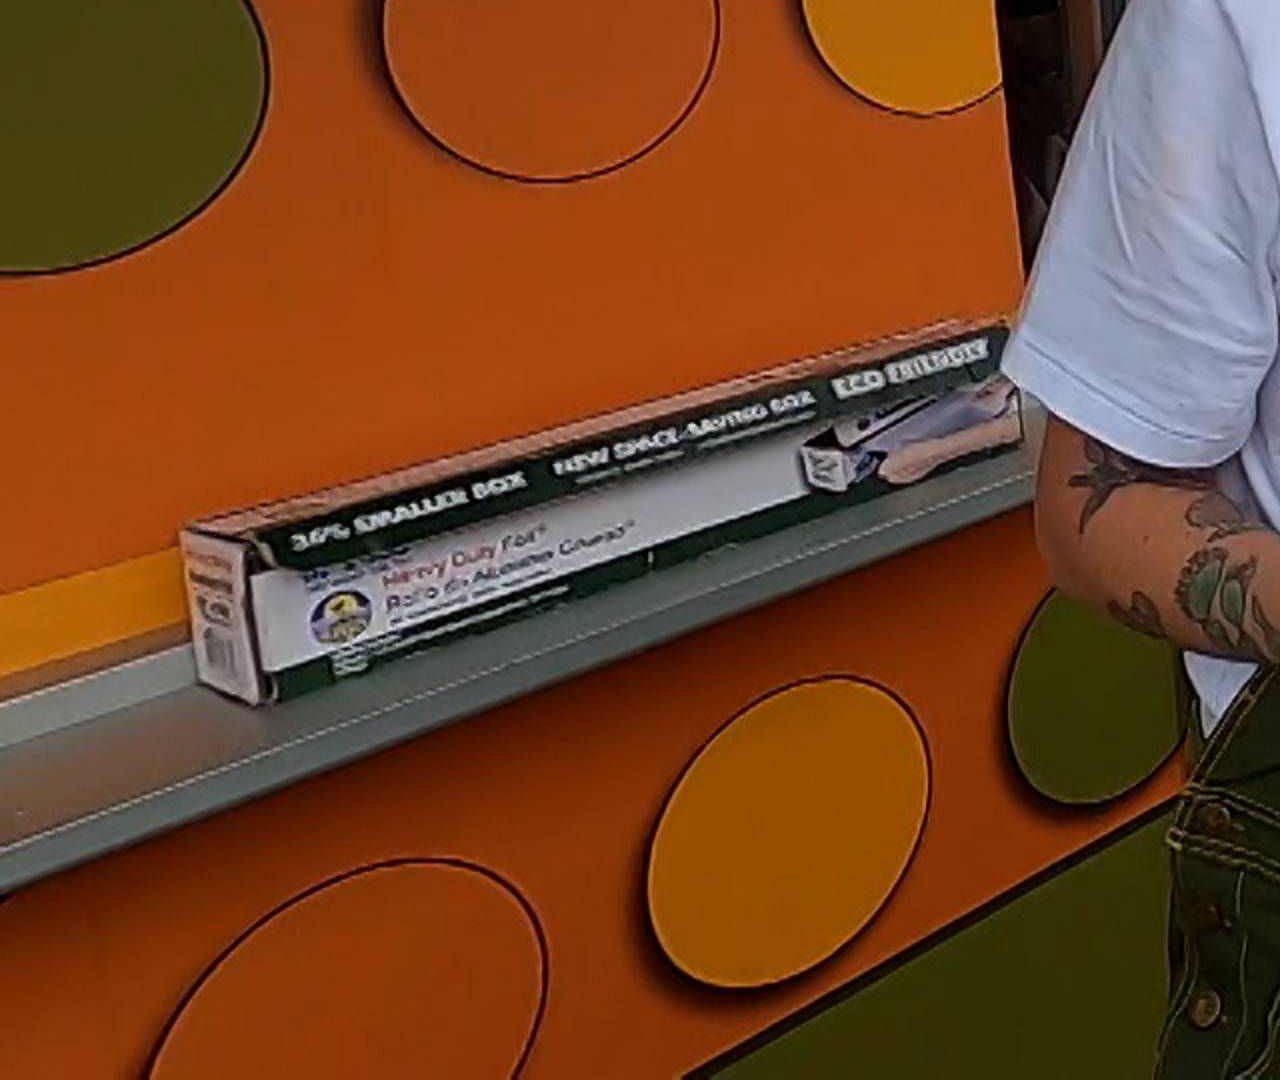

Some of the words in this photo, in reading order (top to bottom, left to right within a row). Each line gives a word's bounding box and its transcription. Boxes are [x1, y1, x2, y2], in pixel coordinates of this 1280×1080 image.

[830, 368, 887, 401] ECO
[883, 336, 990, 385] FRIENDLY
[552, 446, 609, 476] NEW
[353, 490, 470, 534] SMALLER
[471, 471, 528, 500] BOX
[381, 559, 447, 589] Heavy
